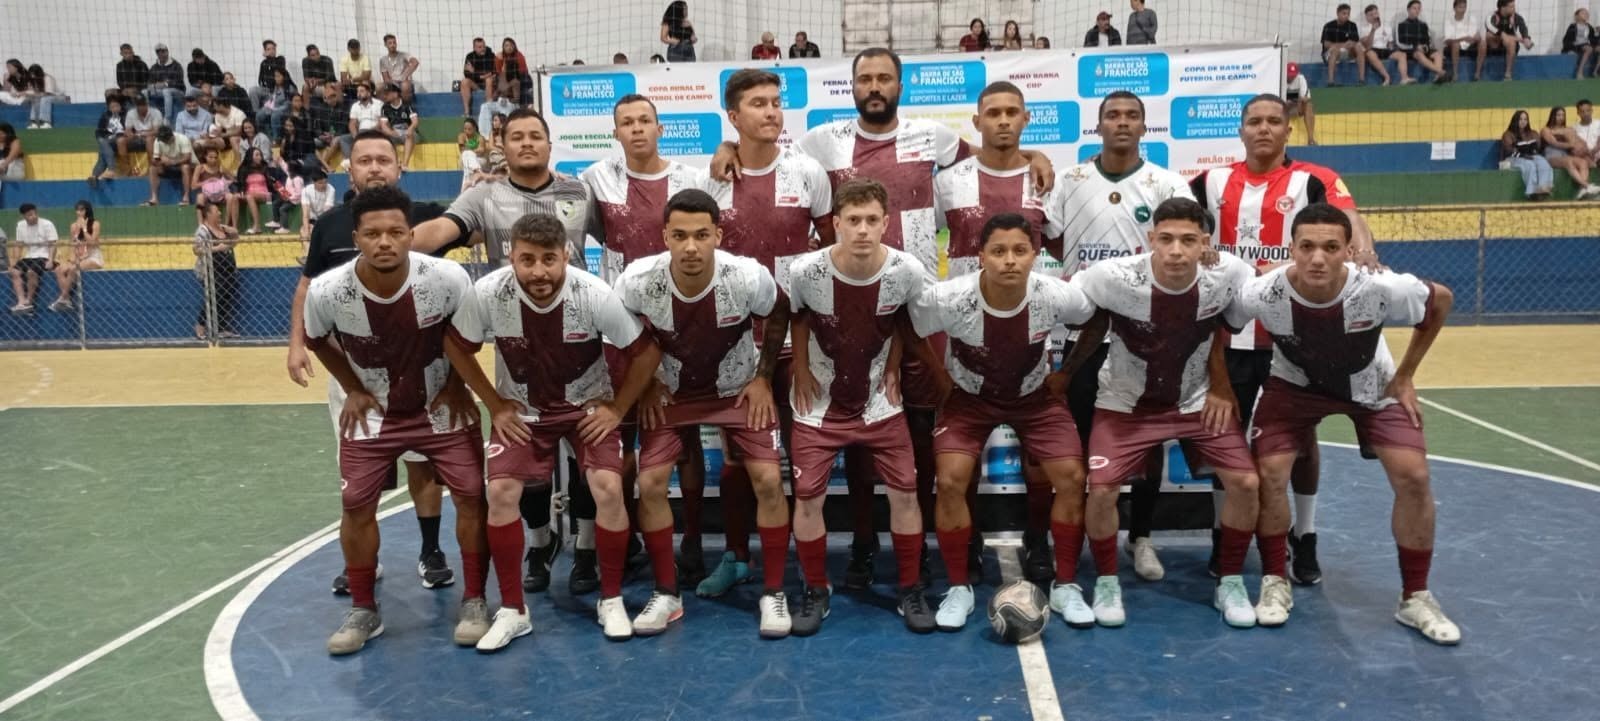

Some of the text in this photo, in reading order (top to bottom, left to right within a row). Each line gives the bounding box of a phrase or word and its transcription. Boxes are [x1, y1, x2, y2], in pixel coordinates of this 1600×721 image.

[1104, 68, 1148, 78] FRANCISCO
[920, 76, 965, 86] FRANCISCO
[572, 84, 592, 92] BARRA
[602, 82, 614, 90] SÃO
[572, 89, 614, 98] FRANCISCO
[1229, 102, 1241, 110] SÃO
[563, 108, 592, 116] ESPORTES
[1197, 110, 1242, 118] FRANCISCO
[1187, 128, 1218, 136] ESPORTES
